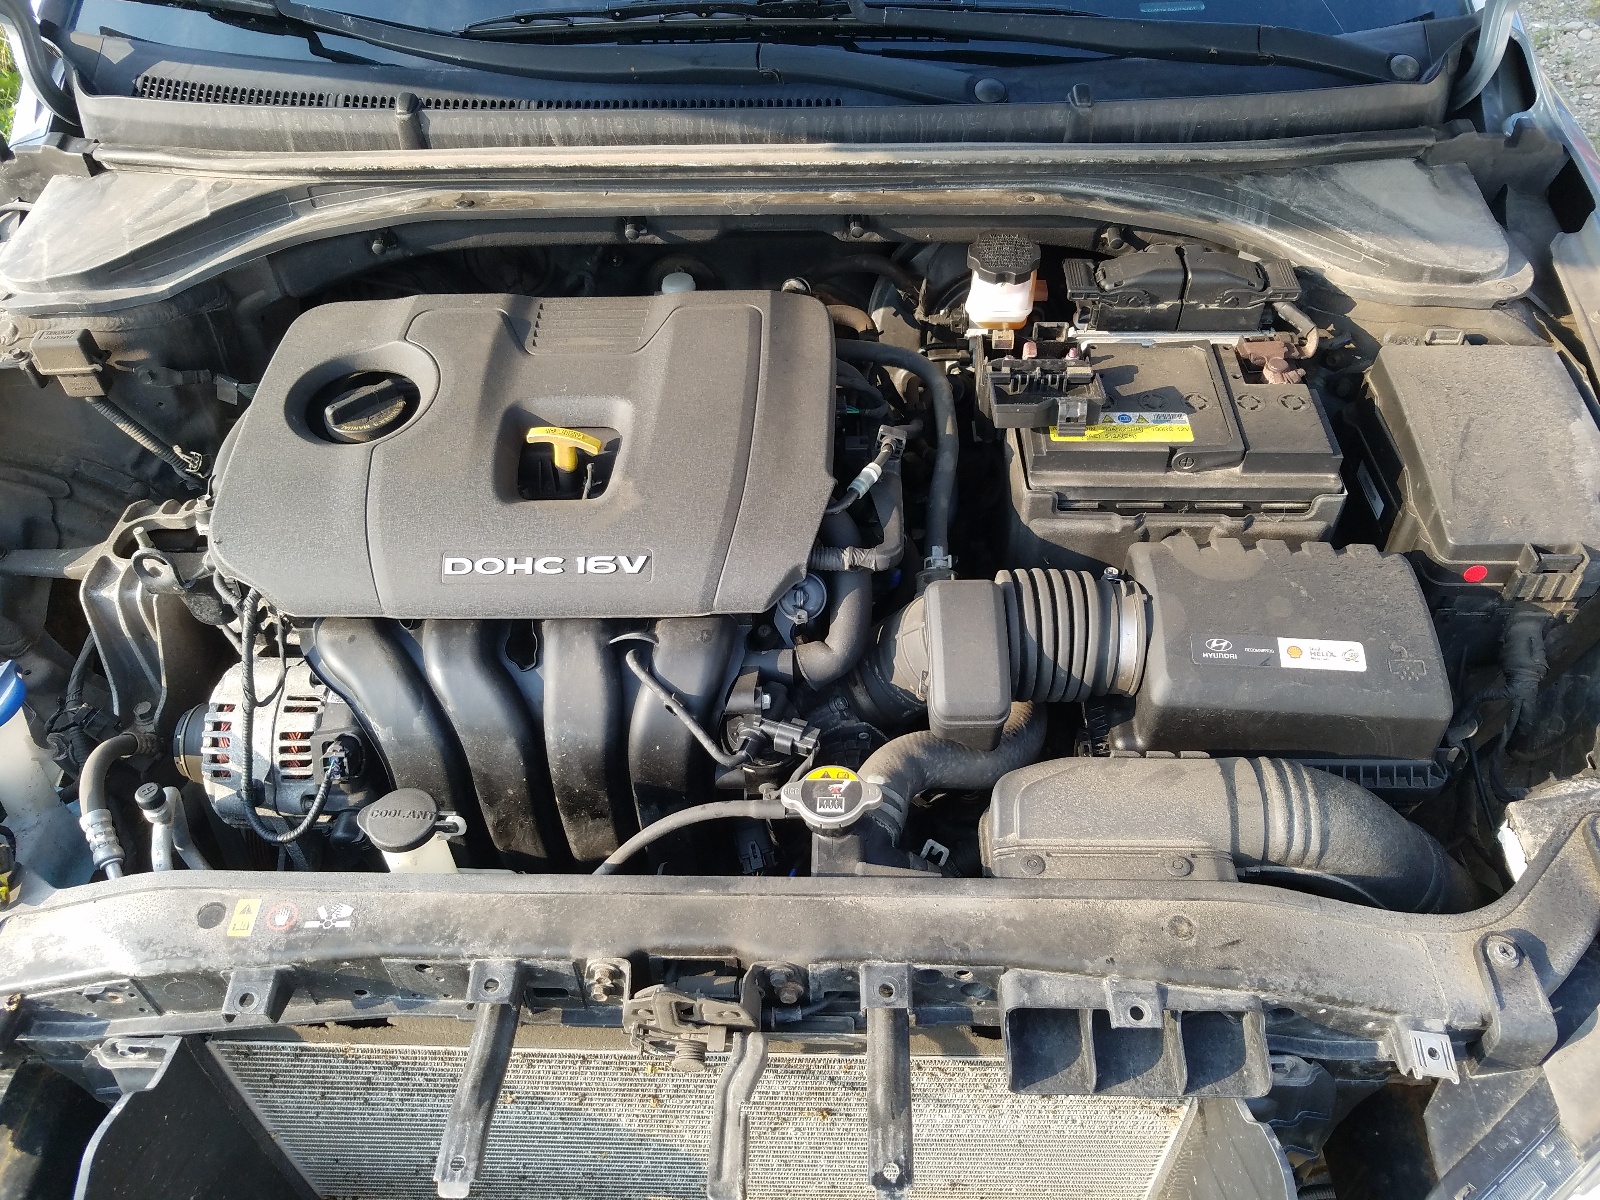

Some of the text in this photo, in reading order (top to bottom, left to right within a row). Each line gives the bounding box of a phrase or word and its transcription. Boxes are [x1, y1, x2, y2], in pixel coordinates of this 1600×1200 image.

[443, 555, 651, 576] DOHC 16V
[1202, 652, 1238, 660] HYUNDAI
[371, 809, 436, 821] COOLANT
